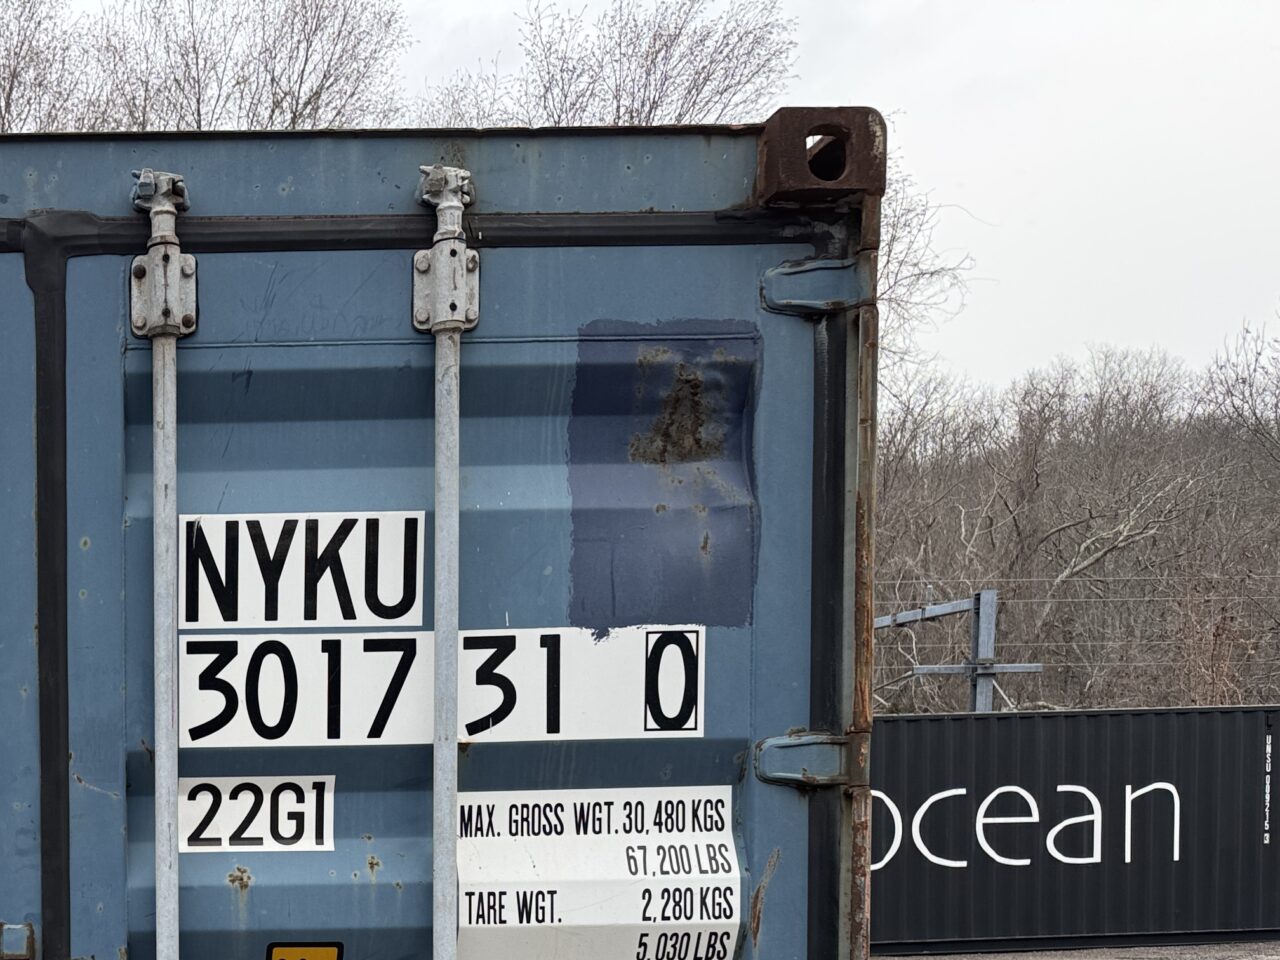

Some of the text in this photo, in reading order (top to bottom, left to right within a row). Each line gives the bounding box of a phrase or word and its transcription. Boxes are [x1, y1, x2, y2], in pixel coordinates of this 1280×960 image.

[185, 517, 419, 622] NYKU
[645, 631, 698, 731] 0
[187, 781, 326, 846] 22G1
[460, 799, 726, 838] MAX. GROSS WGT. 30,480 KGS
[626, 843, 732, 877] 67,200 LBS
[465, 886, 734, 925] TARE WGT. 2,280 KGS
[693, 931, 730, 960] LBS
